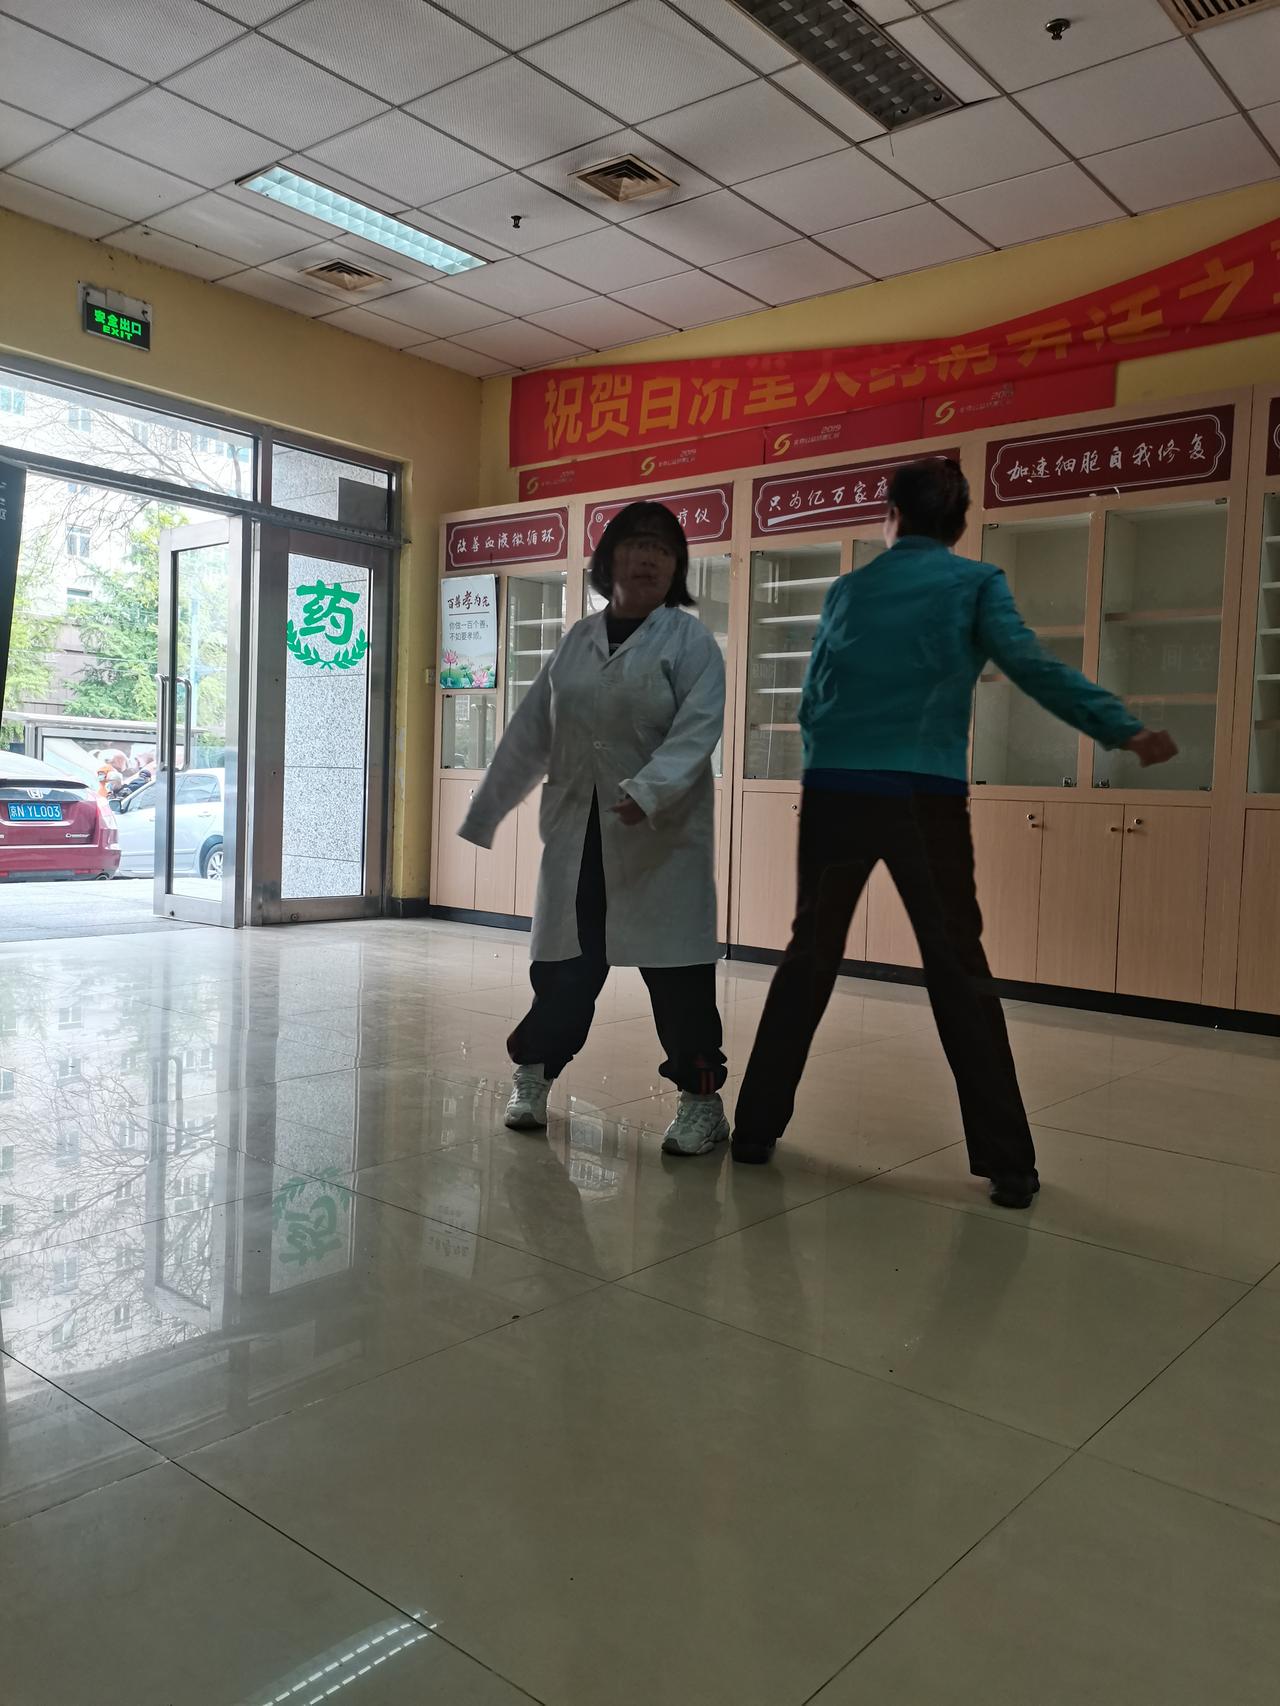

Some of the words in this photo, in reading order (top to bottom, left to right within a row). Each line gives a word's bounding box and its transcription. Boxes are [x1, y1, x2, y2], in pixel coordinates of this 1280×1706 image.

[94, 309, 142, 336] 安全出口
[102, 325, 133, 341] EXIT
[1006, 432, 1207, 483] 加速细胞自我修复
[456, 527, 555, 553] 改善血液微循环
[296, 579, 361, 646] 药
